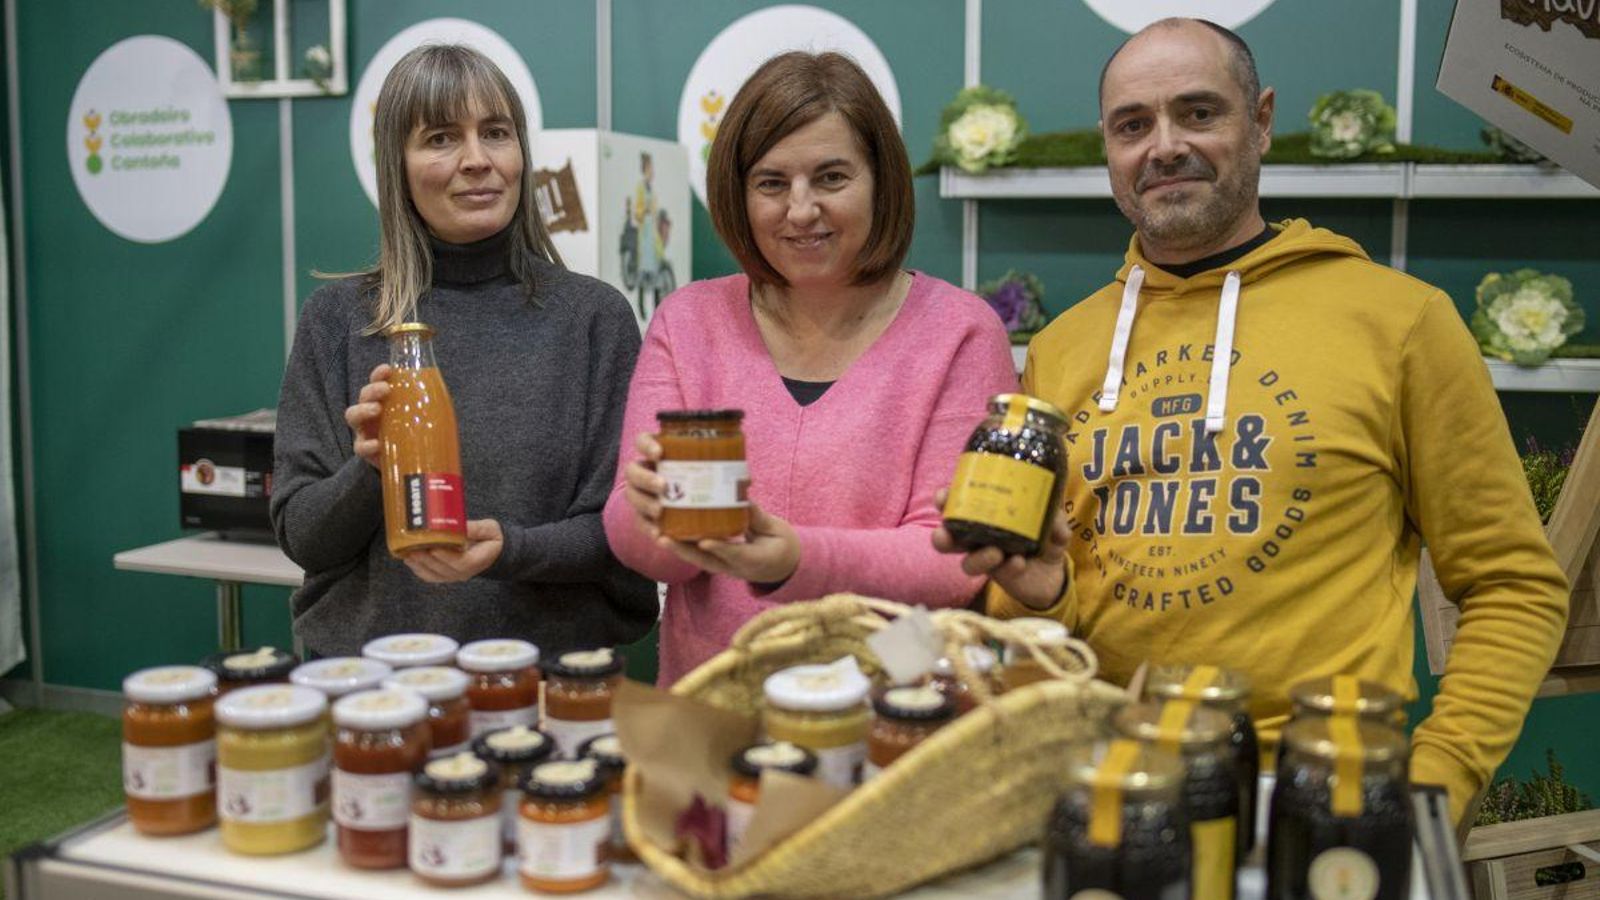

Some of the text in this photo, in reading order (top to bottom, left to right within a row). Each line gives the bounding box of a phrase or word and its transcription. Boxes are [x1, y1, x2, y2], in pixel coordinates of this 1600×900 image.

[110, 107, 192, 126] Obradeiro
[111, 130, 216, 148] Colaborativo
[1161, 397, 1192, 415] MFG
[1259, 370, 1317, 468] DENIM
[1093, 477, 1261, 536] JONES
[1246, 487, 1312, 573] GOODS
[1108, 547, 1227, 577] NINETEEN NINETY
[1114, 576, 1234, 611] CRAFTED
